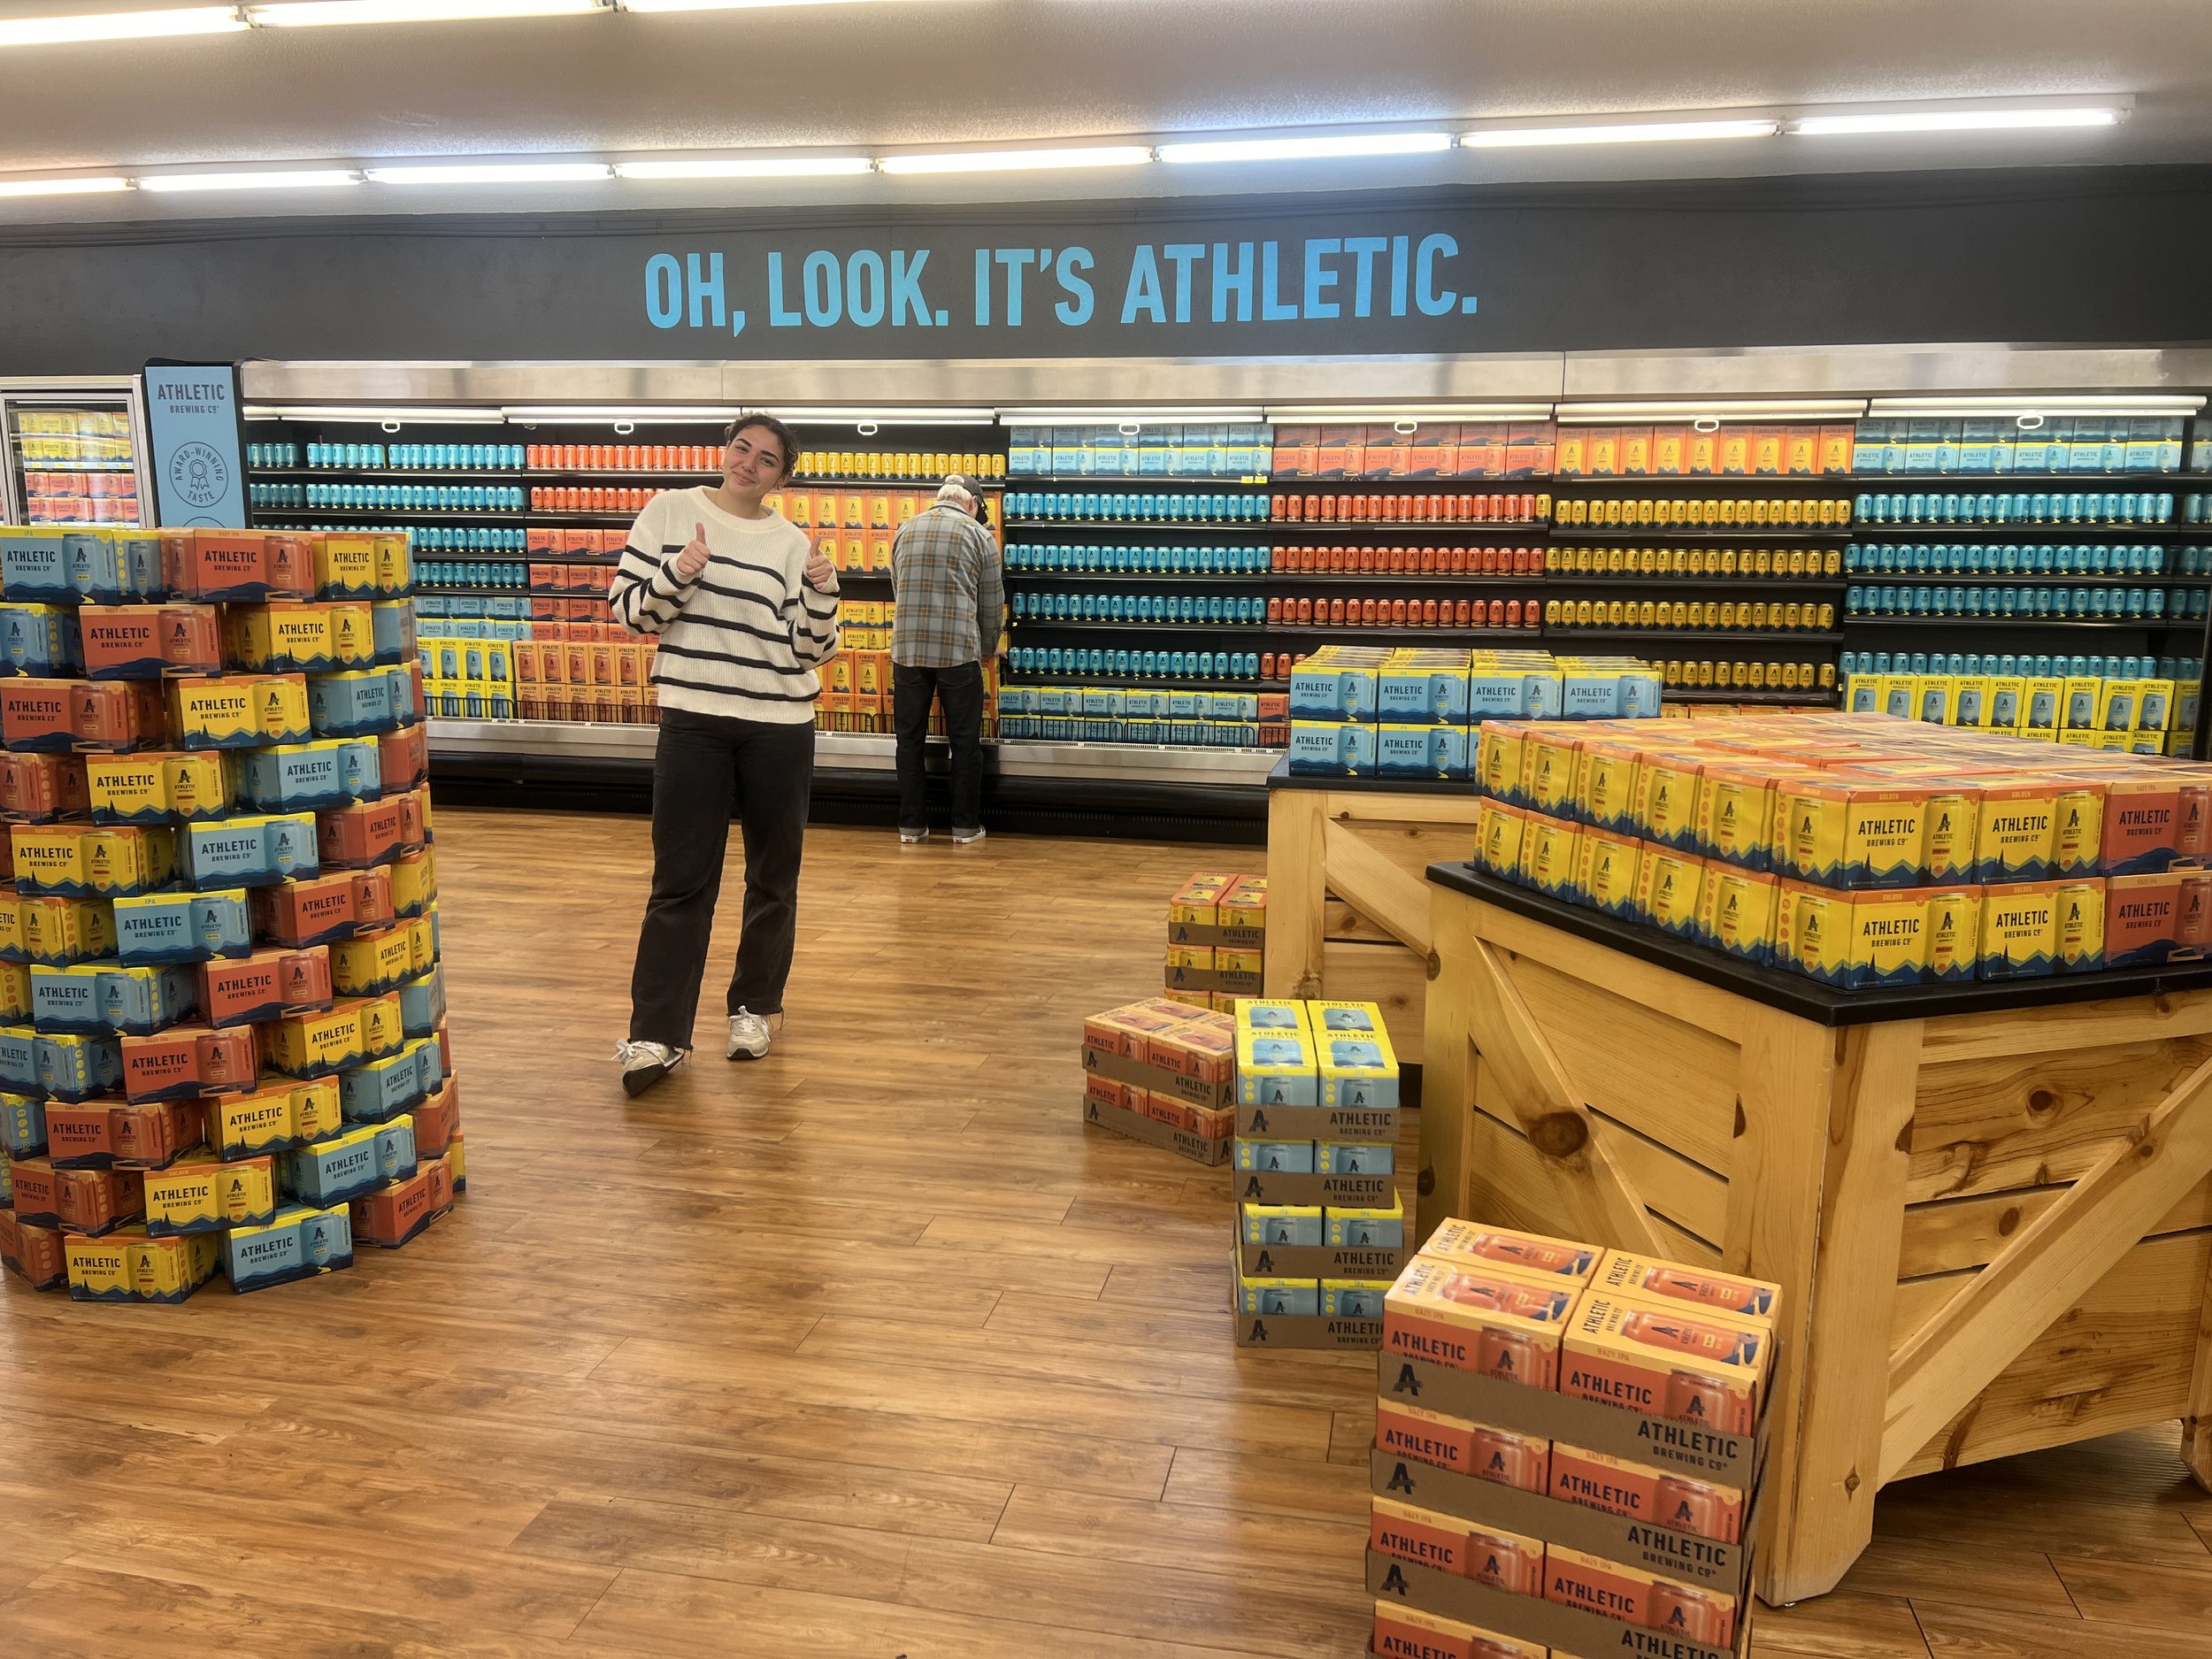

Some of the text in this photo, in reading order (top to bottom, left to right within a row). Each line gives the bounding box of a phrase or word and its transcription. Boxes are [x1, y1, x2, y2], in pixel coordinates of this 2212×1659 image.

[644, 251, 747, 337] OH,
[768, 249, 949, 328] LOOK.
[1120, 234, 1478, 324] ATHLETIC.
[158, 384, 225, 400] ATHLETIC
[174, 447, 224, 480] AWARD-WINNING
[188, 490, 215, 503] TASTE
[7, 551, 56, 563] ATHLETIC
[205, 551, 257, 563] ATHLETIC
[334, 552, 369, 563] ATHLETIC
[90, 627, 150, 639] ATHLETIC
[279, 623, 325, 634] ATHLETIC
[357, 687, 384, 702] ATHLETIC
[1295, 683, 1333, 693] ATHLETIC
[1384, 686, 1423, 695] ATHLETIC
[1477, 687, 1516, 696] ATHLETIC
[1571, 687, 1611, 697] ATHLETIC
[8, 701, 62, 712] ATHLETIC
[190, 697, 247, 711] ATHLETIC
[1295, 736, 1333, 746] ATHLETIC
[1384, 739, 1423, 749] ATHLETIC
[287, 761, 332, 776] ATHLETIC
[96, 775, 155, 787] ATHLETIC
[370, 817, 396, 833] ATHLETIC
[1993, 816, 2047, 833] ATHLETIC
[2119, 810, 2170, 826] ATHLETIC
[1858, 819, 1916, 835] ATHLETIC
[19, 848, 73, 858] ATHLETIC
[202, 840, 257, 854] ATHLETIC
[303, 895, 346, 912] ATHLETIC
[2119, 902, 2170, 918] ATHLETIC
[124, 917, 181, 930] ATHLETIC
[1996, 910, 2048, 927] ATHLETIC
[2125, 920, 2152, 929] BREWING
[1223, 929, 1259, 938] ATHLETIC
[1863, 919, 1919, 935] ATHLETIC
[380, 942, 406, 959] ATHLETIC
[1871, 939, 1901, 948] BREWING
[218, 976, 272, 991] ATHLETIC
[39, 987, 88, 998] ATHLETIC
[312, 1024, 355, 1043] ATHLETIC
[1087, 1035, 1115, 1049] ATHLETIC
[132, 1054, 188, 1069] ATHLETIC
[1152, 1053, 1180, 1068] ATHLETIC
[386, 1066, 412, 1087] ATHLETIC
[1175, 1077, 1210, 1094] ATHLETIC
[1090, 1087, 1116, 1102] ATHLETIC
[230, 1107, 283, 1125] ATHLETIC
[1152, 1108, 1179, 1124] ATHLETIC
[1330, 1113, 1391, 1125] ATHLETIC
[53, 1124, 102, 1134] ATHLETIC
[1174, 1133, 1208, 1151] ATHLETIC
[326, 1151, 369, 1174] ATHLETIC
[15, 1179, 50, 1194] ATHLETIC
[1324, 1179, 1384, 1192] ATHLETIC
[153, 1187, 209, 1201] ATHLETIC
[398, 1188, 425, 1214] ATHLETIC
[241, 1237, 293, 1258] ATHLETIC
[73, 1257, 120, 1267] ATHLETIC
[1334, 1253, 1394, 1264] ATHLETIC
[1607, 1256, 1632, 1286] ATHLETIC
[1582, 1299, 1610, 1334] ATHLETIC
[1392, 1330, 1466, 1361] ATHLETIC
[1571, 1371, 1652, 1404] ATHLETIC
[1386, 1430, 1457, 1461] ATHLETIC
[1638, 1420, 1739, 1459] ATHLETIC
[1652, 1446, 1703, 1464] BREWING
[1560, 1474, 1641, 1509] ATHLETIC
[1380, 1532, 1453, 1563] ATHLETIC
[1628, 1526, 1727, 1566] ATHLETIC
[1642, 1551, 1694, 1571] BREWING
[1555, 1578, 1635, 1614] ATHLETIC
